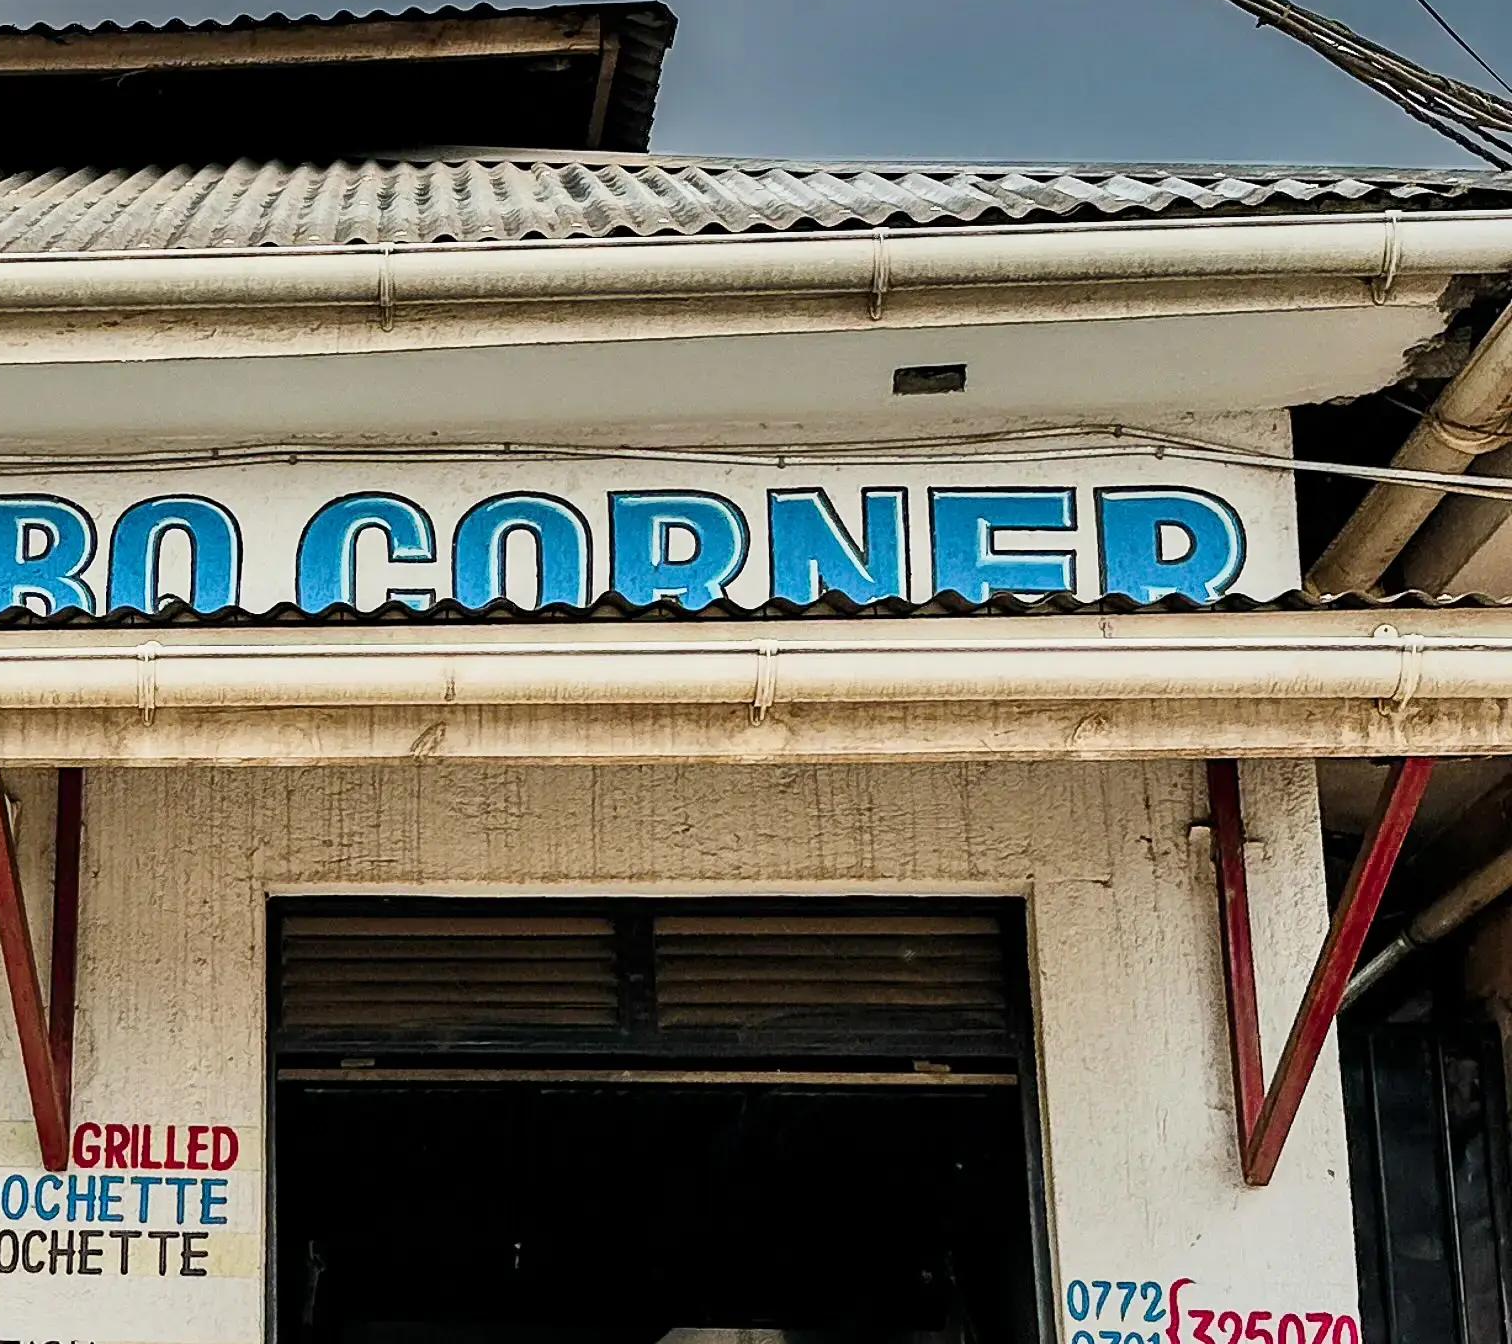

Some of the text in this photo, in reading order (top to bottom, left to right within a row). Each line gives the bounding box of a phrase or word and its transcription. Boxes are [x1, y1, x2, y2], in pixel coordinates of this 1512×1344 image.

[294, 485, 1247, 610] CORNER
[72, 1122, 238, 1171] GRILLED
[1067, 1280, 1166, 1322] 0772
